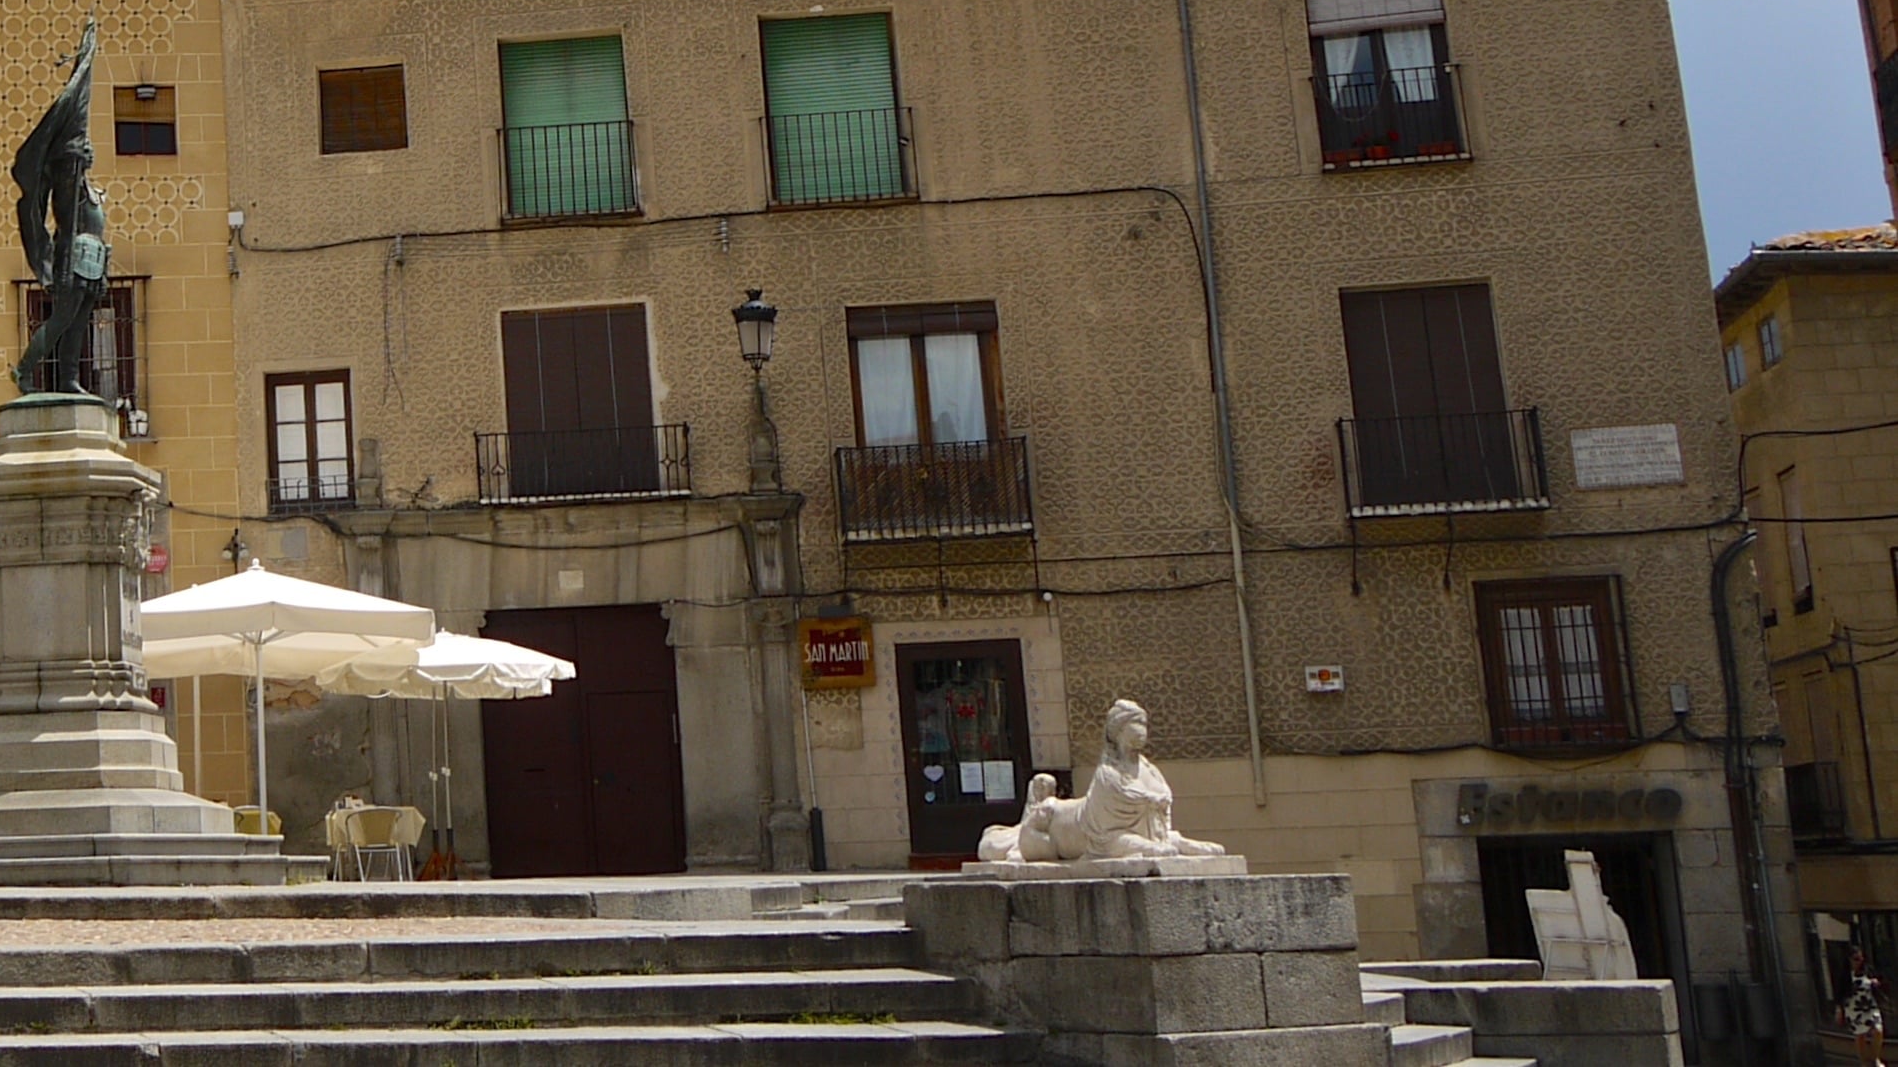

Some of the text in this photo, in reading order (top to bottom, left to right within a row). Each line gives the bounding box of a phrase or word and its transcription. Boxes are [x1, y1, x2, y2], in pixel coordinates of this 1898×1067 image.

[804, 642, 870, 663] SAN MARTIN
[1457, 783, 1683, 826] Estanco
